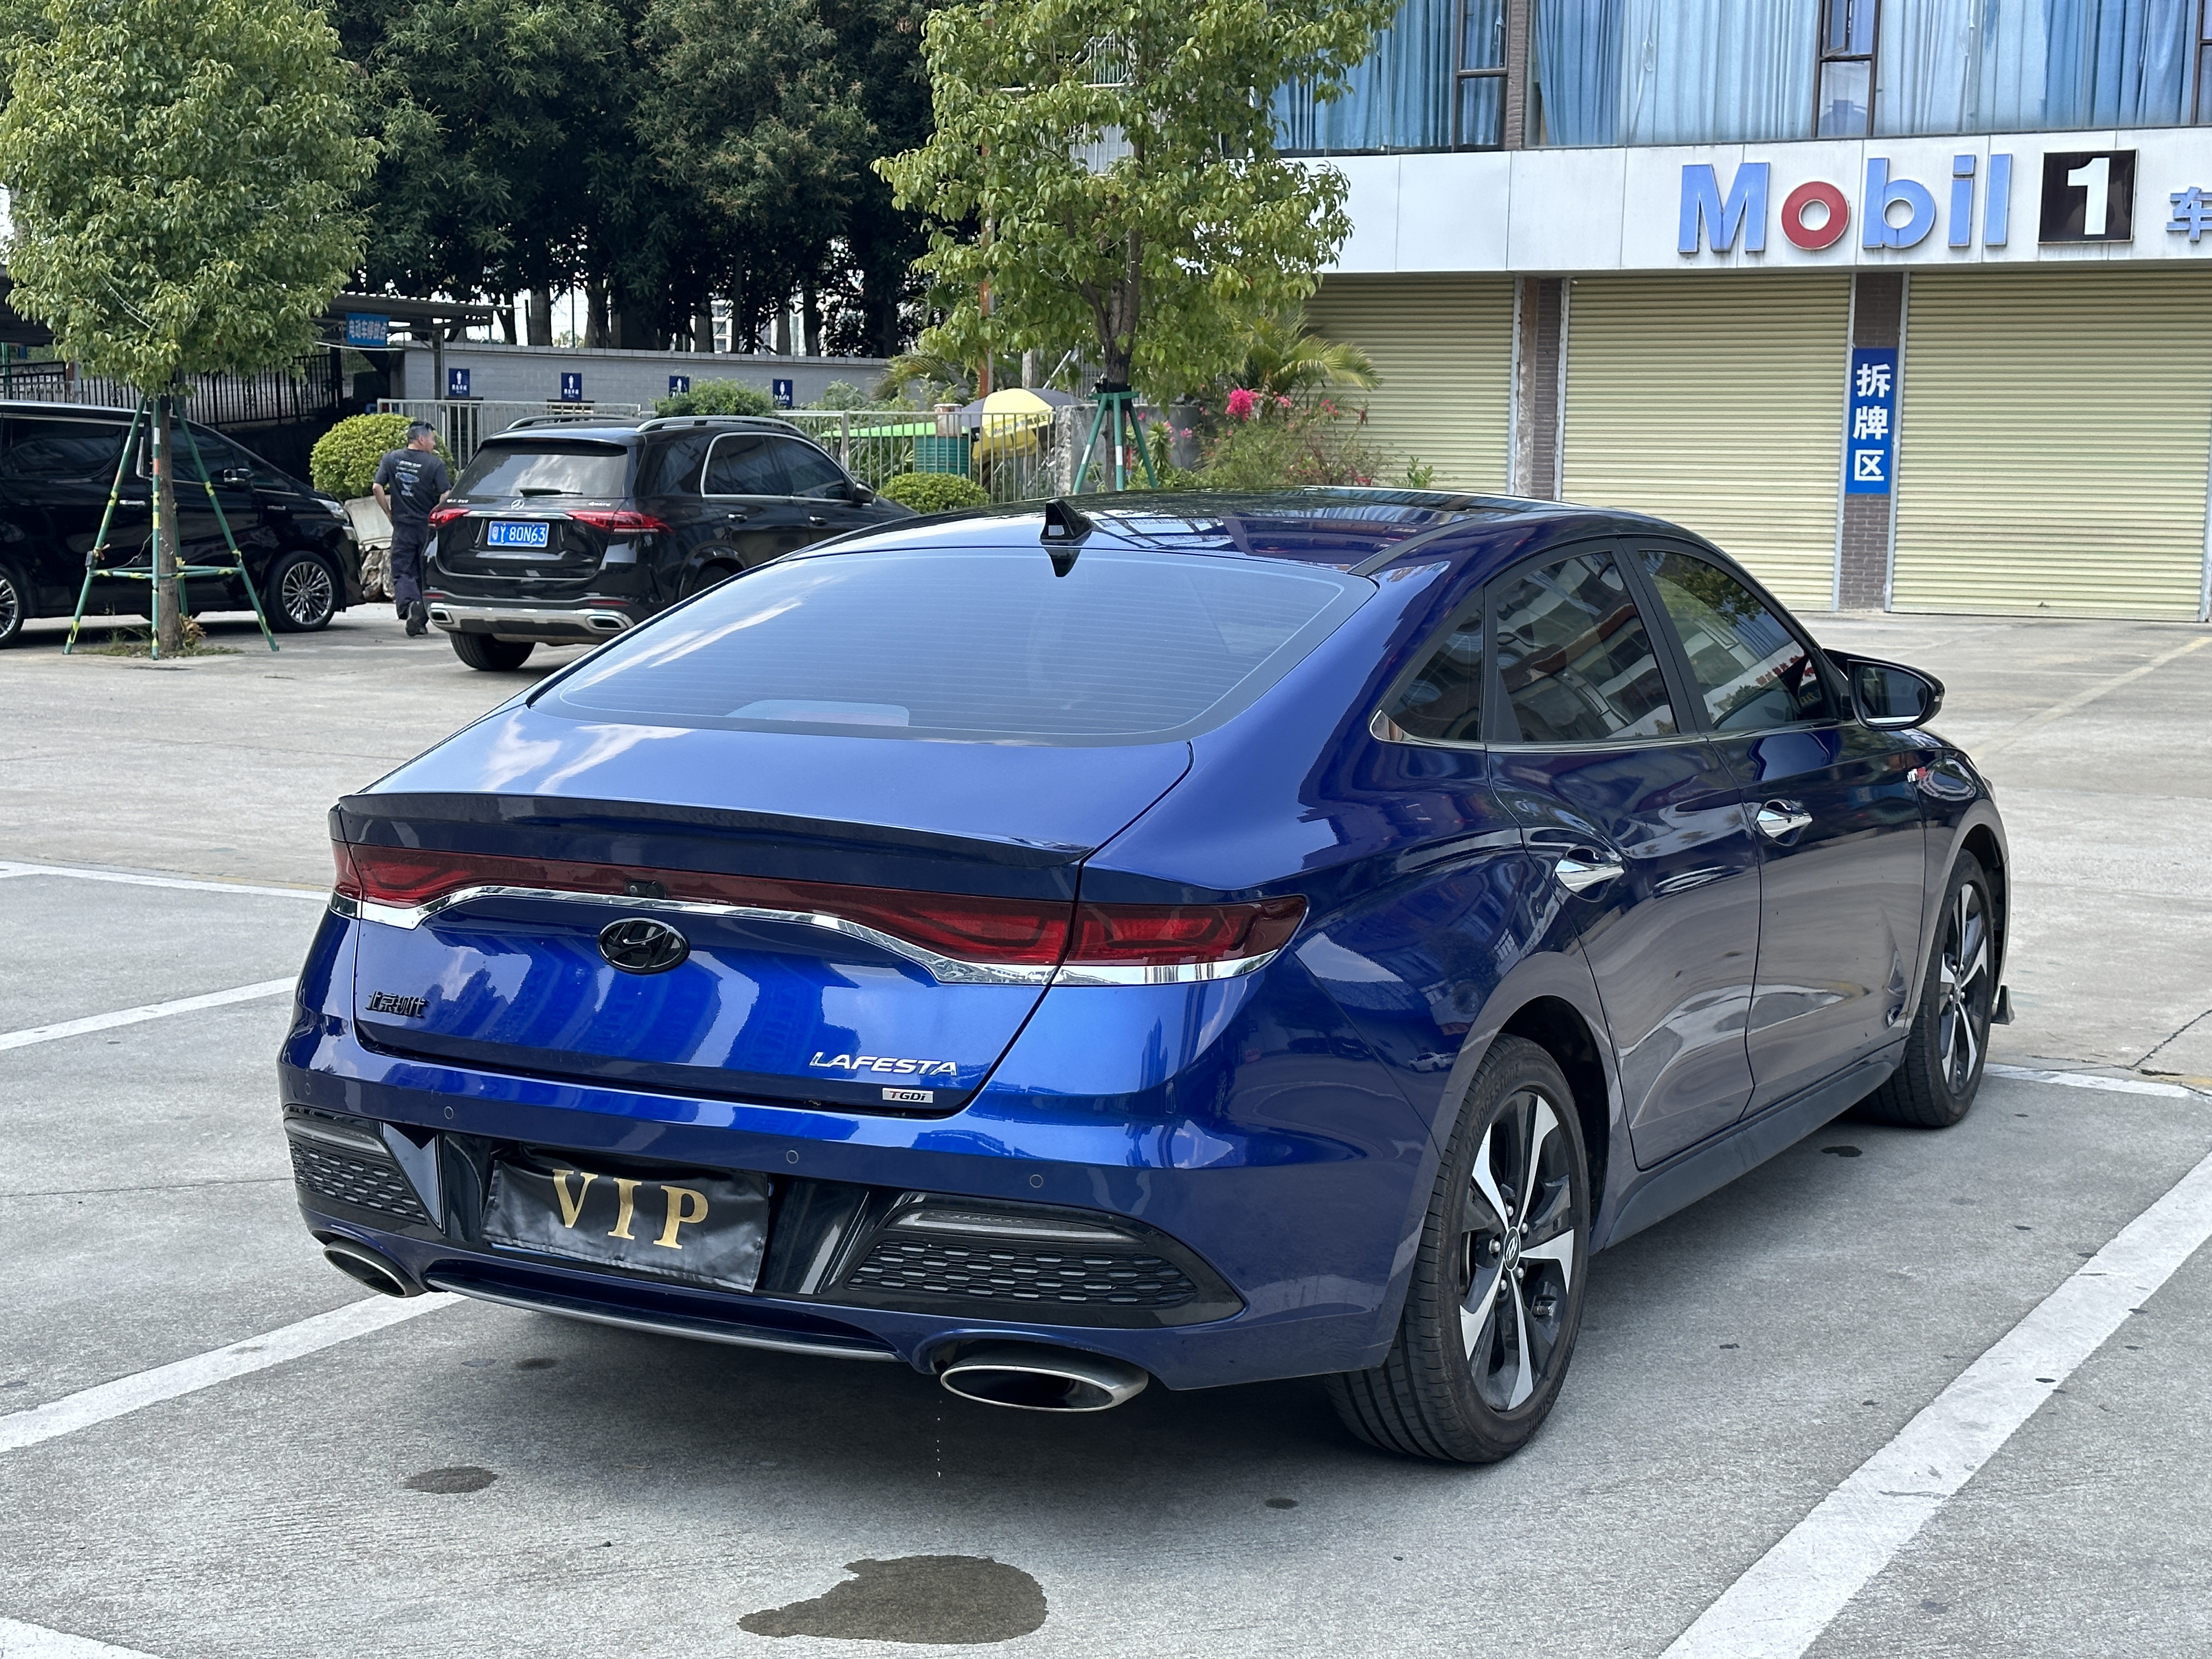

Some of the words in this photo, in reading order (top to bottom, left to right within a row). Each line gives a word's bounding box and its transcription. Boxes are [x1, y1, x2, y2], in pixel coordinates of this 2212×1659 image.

[1677, 153, 2013, 253] Mobil
[2066, 157, 2111, 236] 1
[1853, 363, 1891, 481] 拆牌区
[365, 991, 430, 1019] 北京现代
[809, 1052, 957, 1076] LAFESTA
[889, 1091, 927, 1101] TGDi
[552, 1169, 709, 1250] VIP
